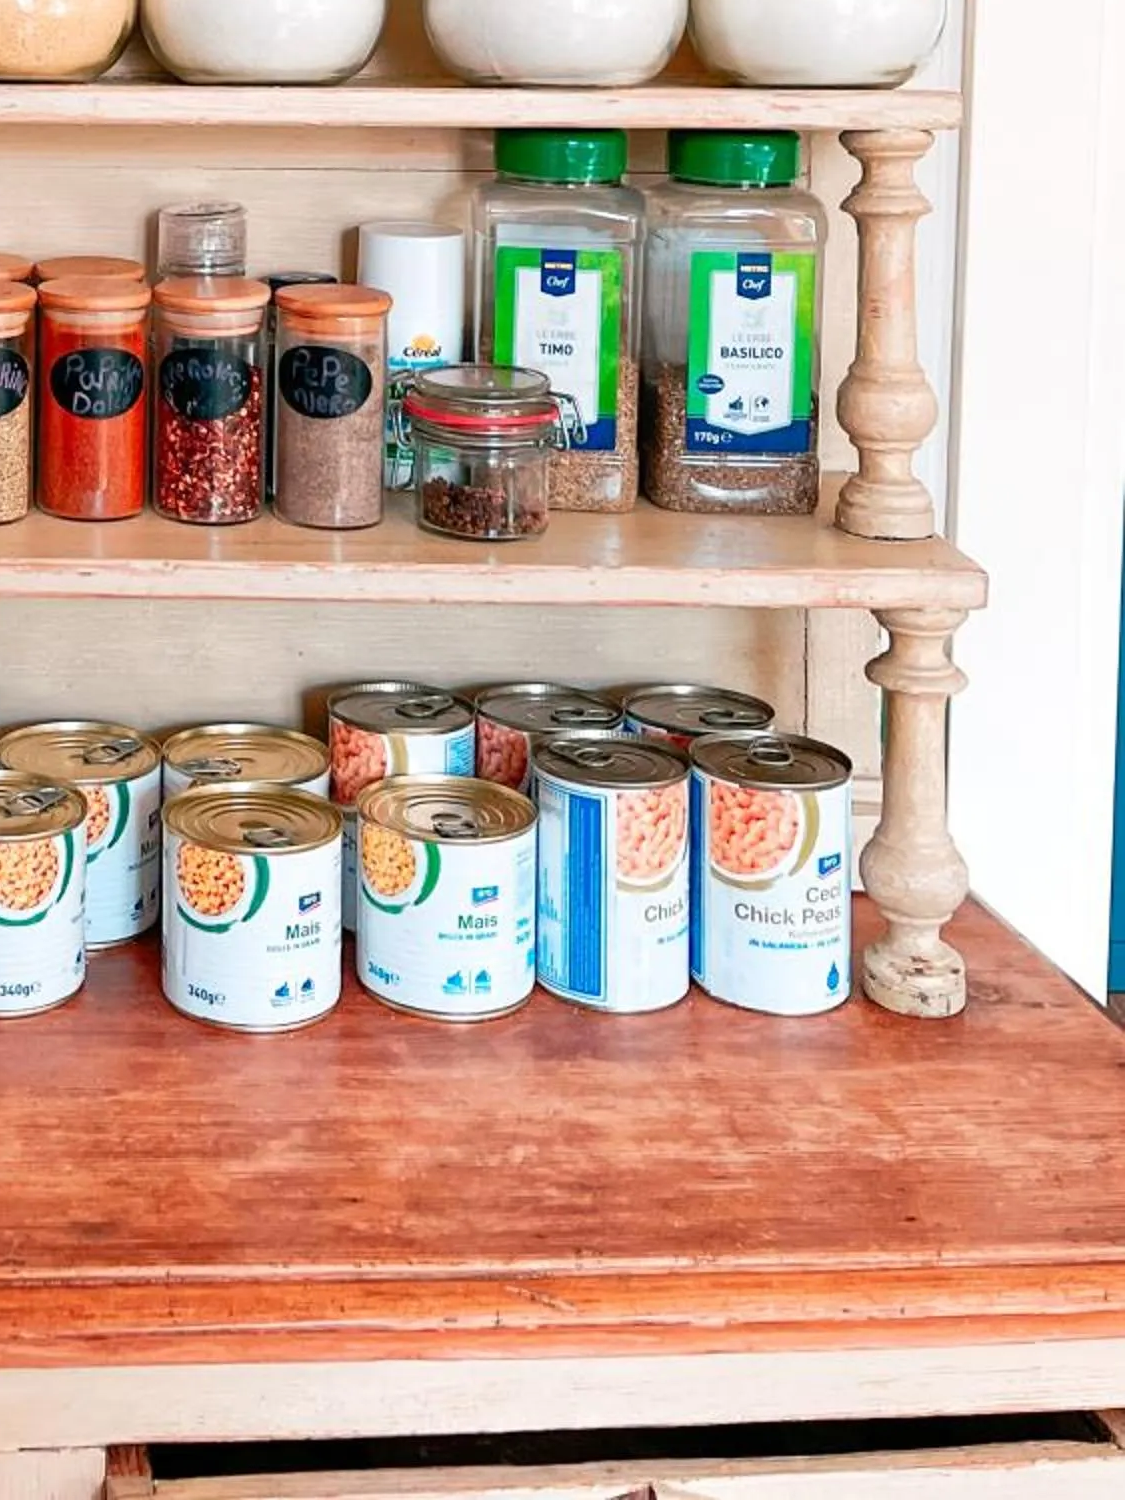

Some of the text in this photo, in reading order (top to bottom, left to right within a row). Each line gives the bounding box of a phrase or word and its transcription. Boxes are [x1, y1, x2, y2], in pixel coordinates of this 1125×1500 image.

[539, 343, 574, 356] TIMO
[720, 346, 784, 360] BASILICO
[458, 914, 498, 930] Mais
[734, 903, 841, 926] Chick Peas
[285, 920, 322, 941] Mais
